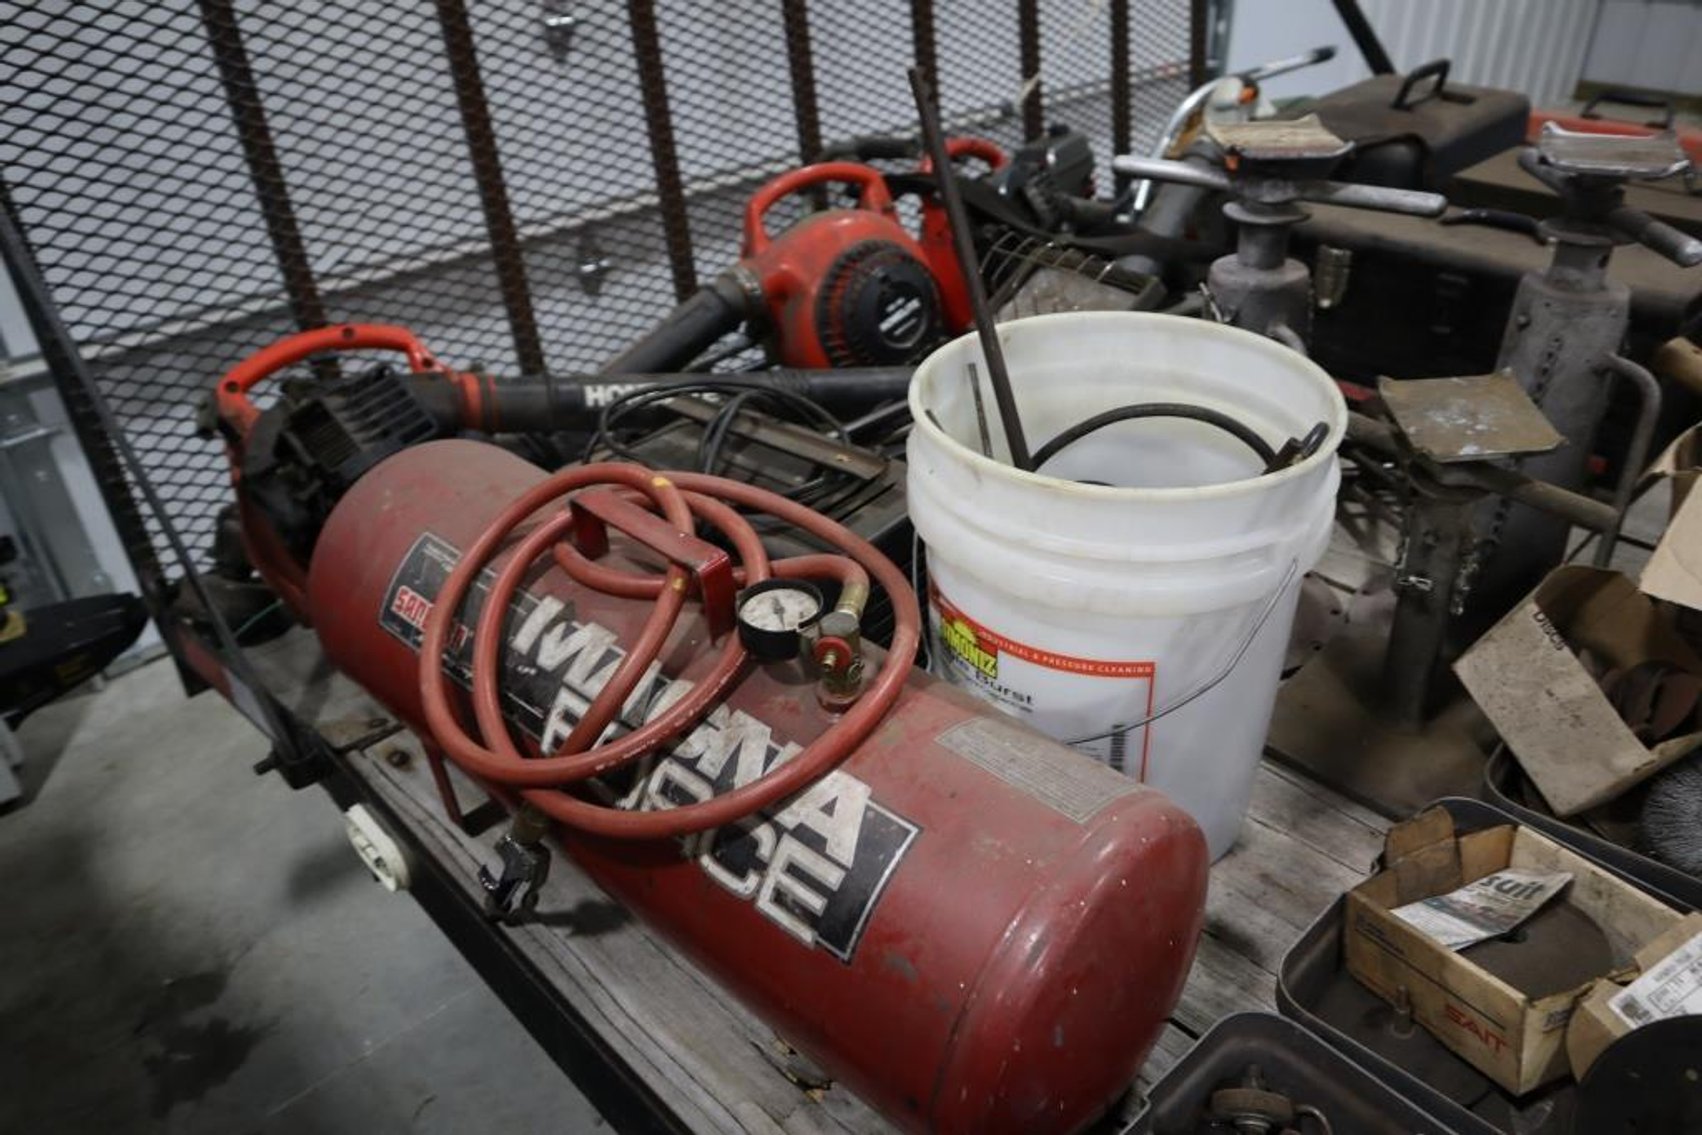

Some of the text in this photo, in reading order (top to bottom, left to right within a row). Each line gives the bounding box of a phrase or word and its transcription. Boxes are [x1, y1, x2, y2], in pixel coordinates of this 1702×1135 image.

[392, 587, 468, 652] SANN
[942, 618, 997, 679] IMONIZ
[1043, 655, 1095, 672] PRESSURE
[1097, 664, 1152, 674] CLEANING
[1444, 1003, 1508, 1053] SAIT
